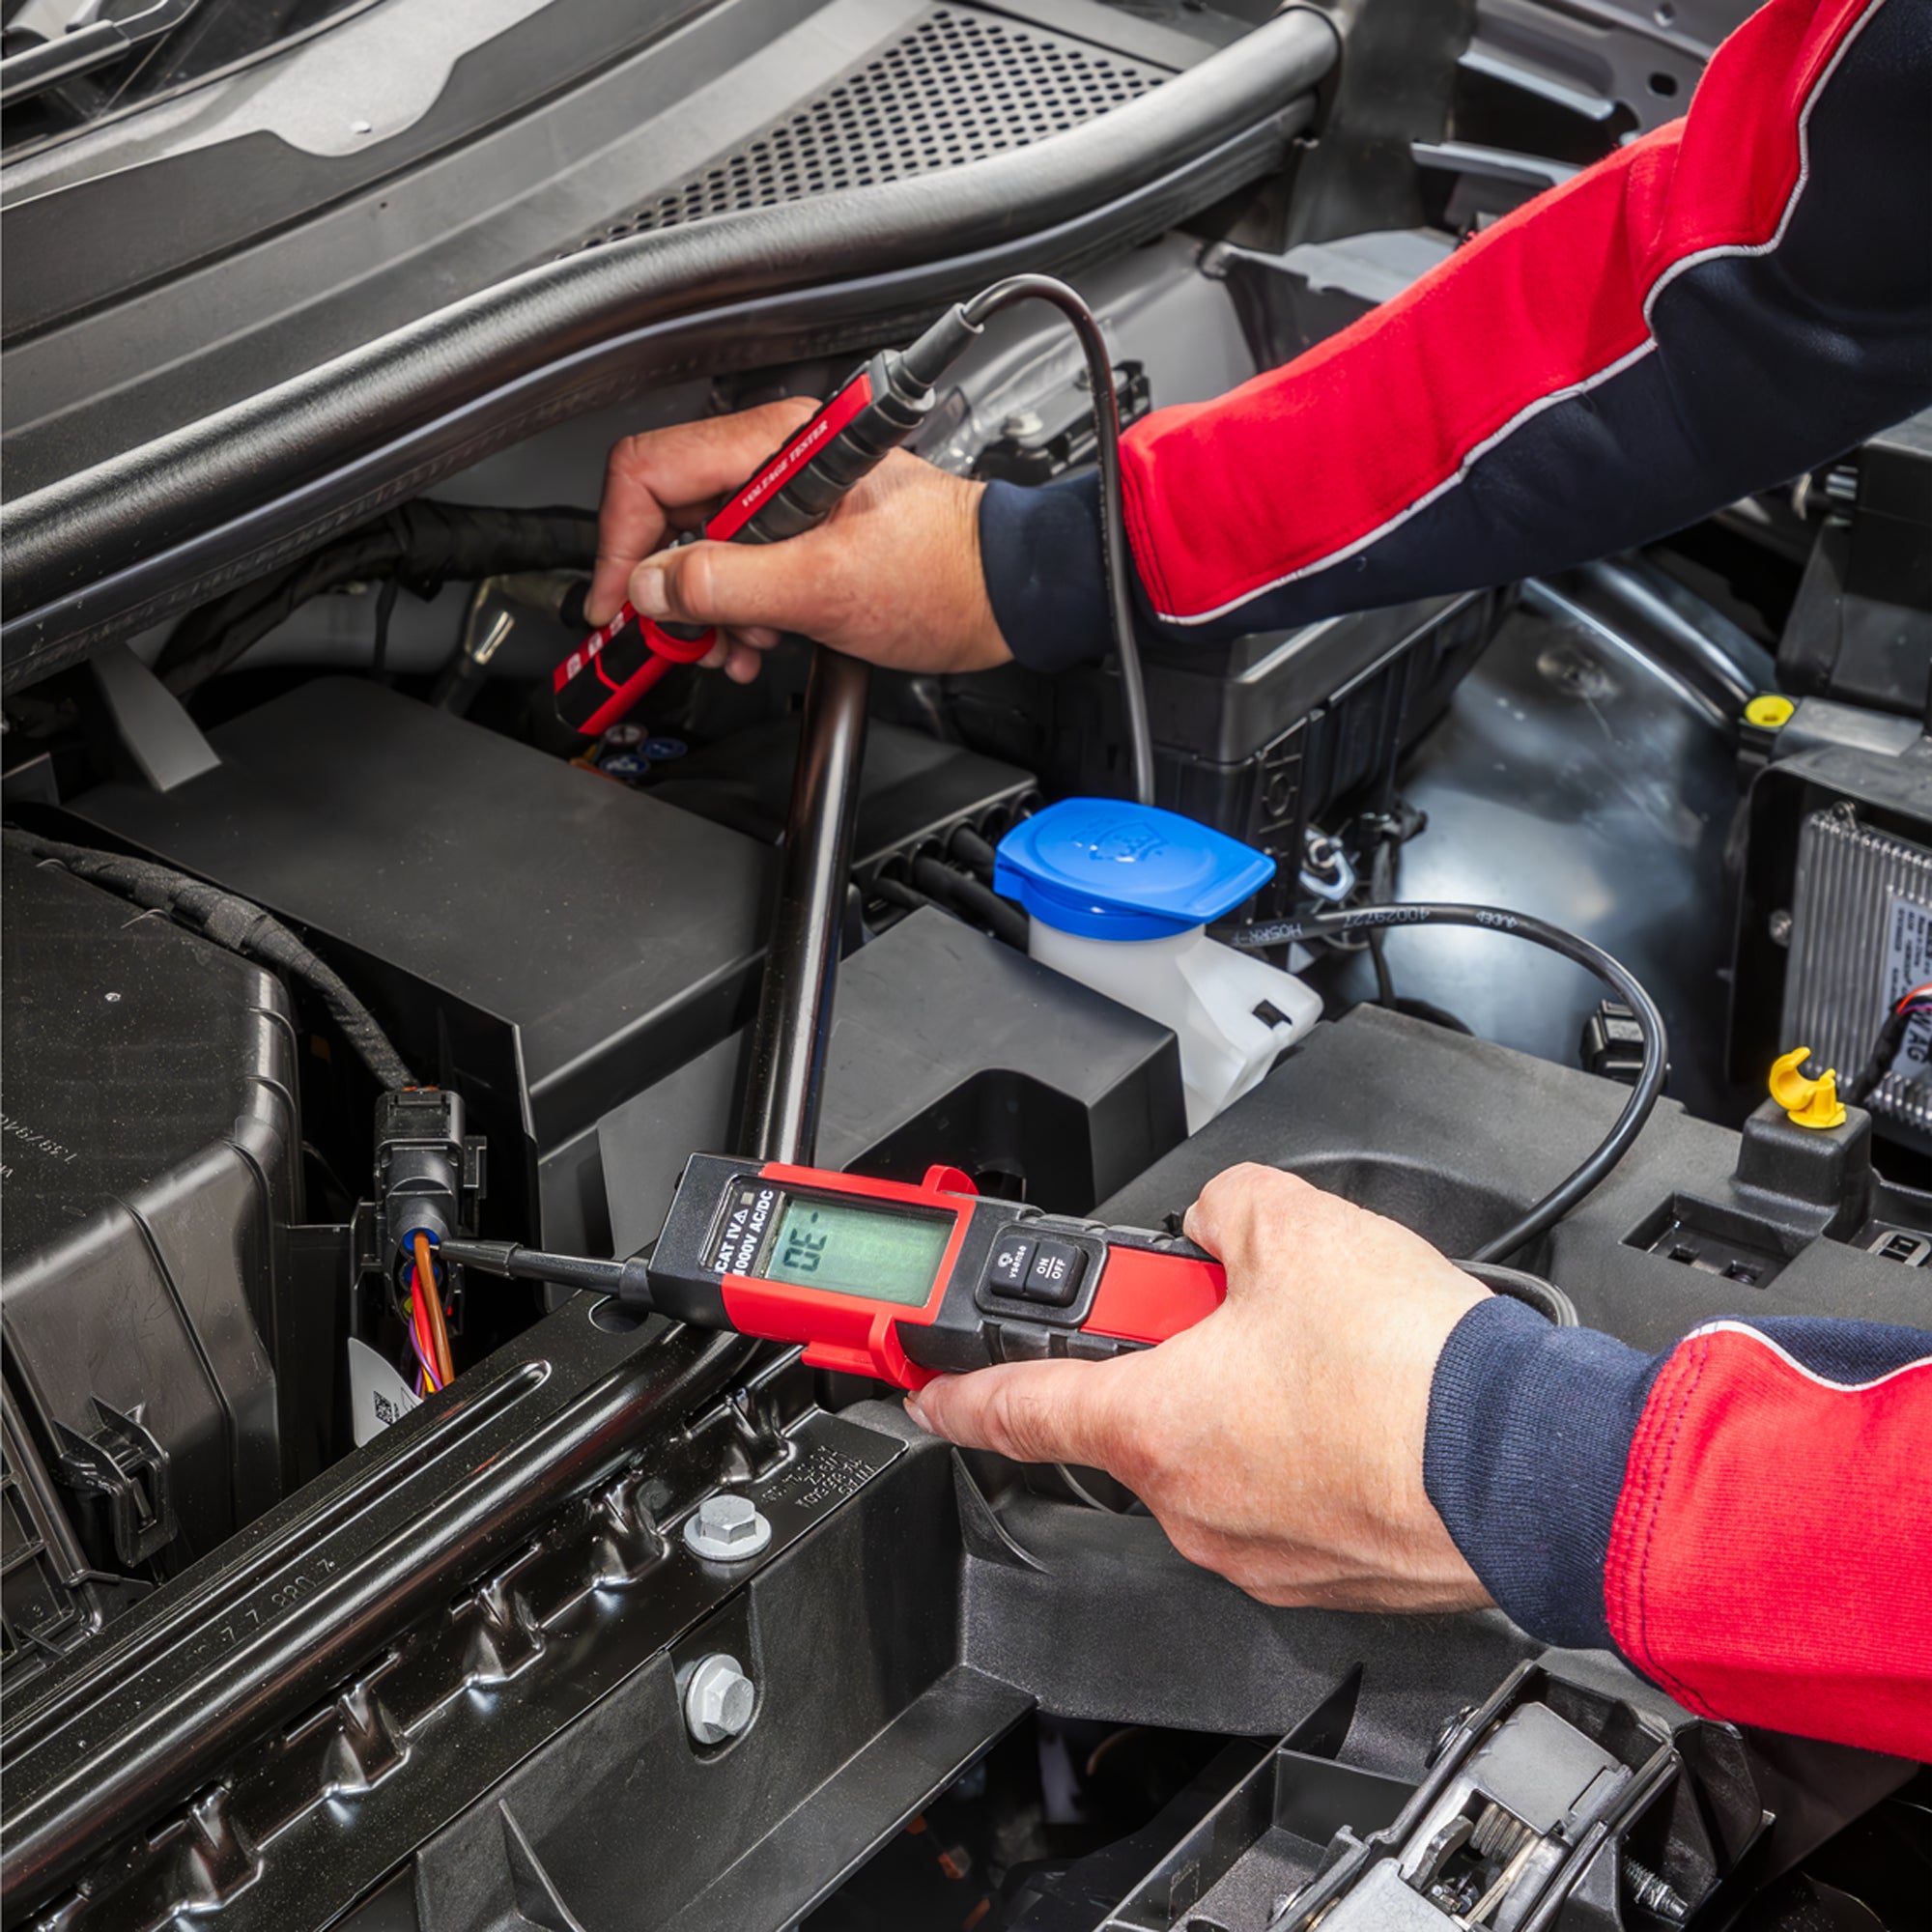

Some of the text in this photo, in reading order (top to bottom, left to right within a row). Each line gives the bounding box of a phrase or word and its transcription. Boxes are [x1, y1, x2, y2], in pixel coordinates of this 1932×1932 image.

[789, 419, 828, 463] TESTER
[714, 1222, 742, 1274] CAT IV
[732, 1190, 774, 1276] 1000V AC/DC
[1037, 1258, 1049, 1274] ON
[1051, 1259, 1065, 1279] OFF
